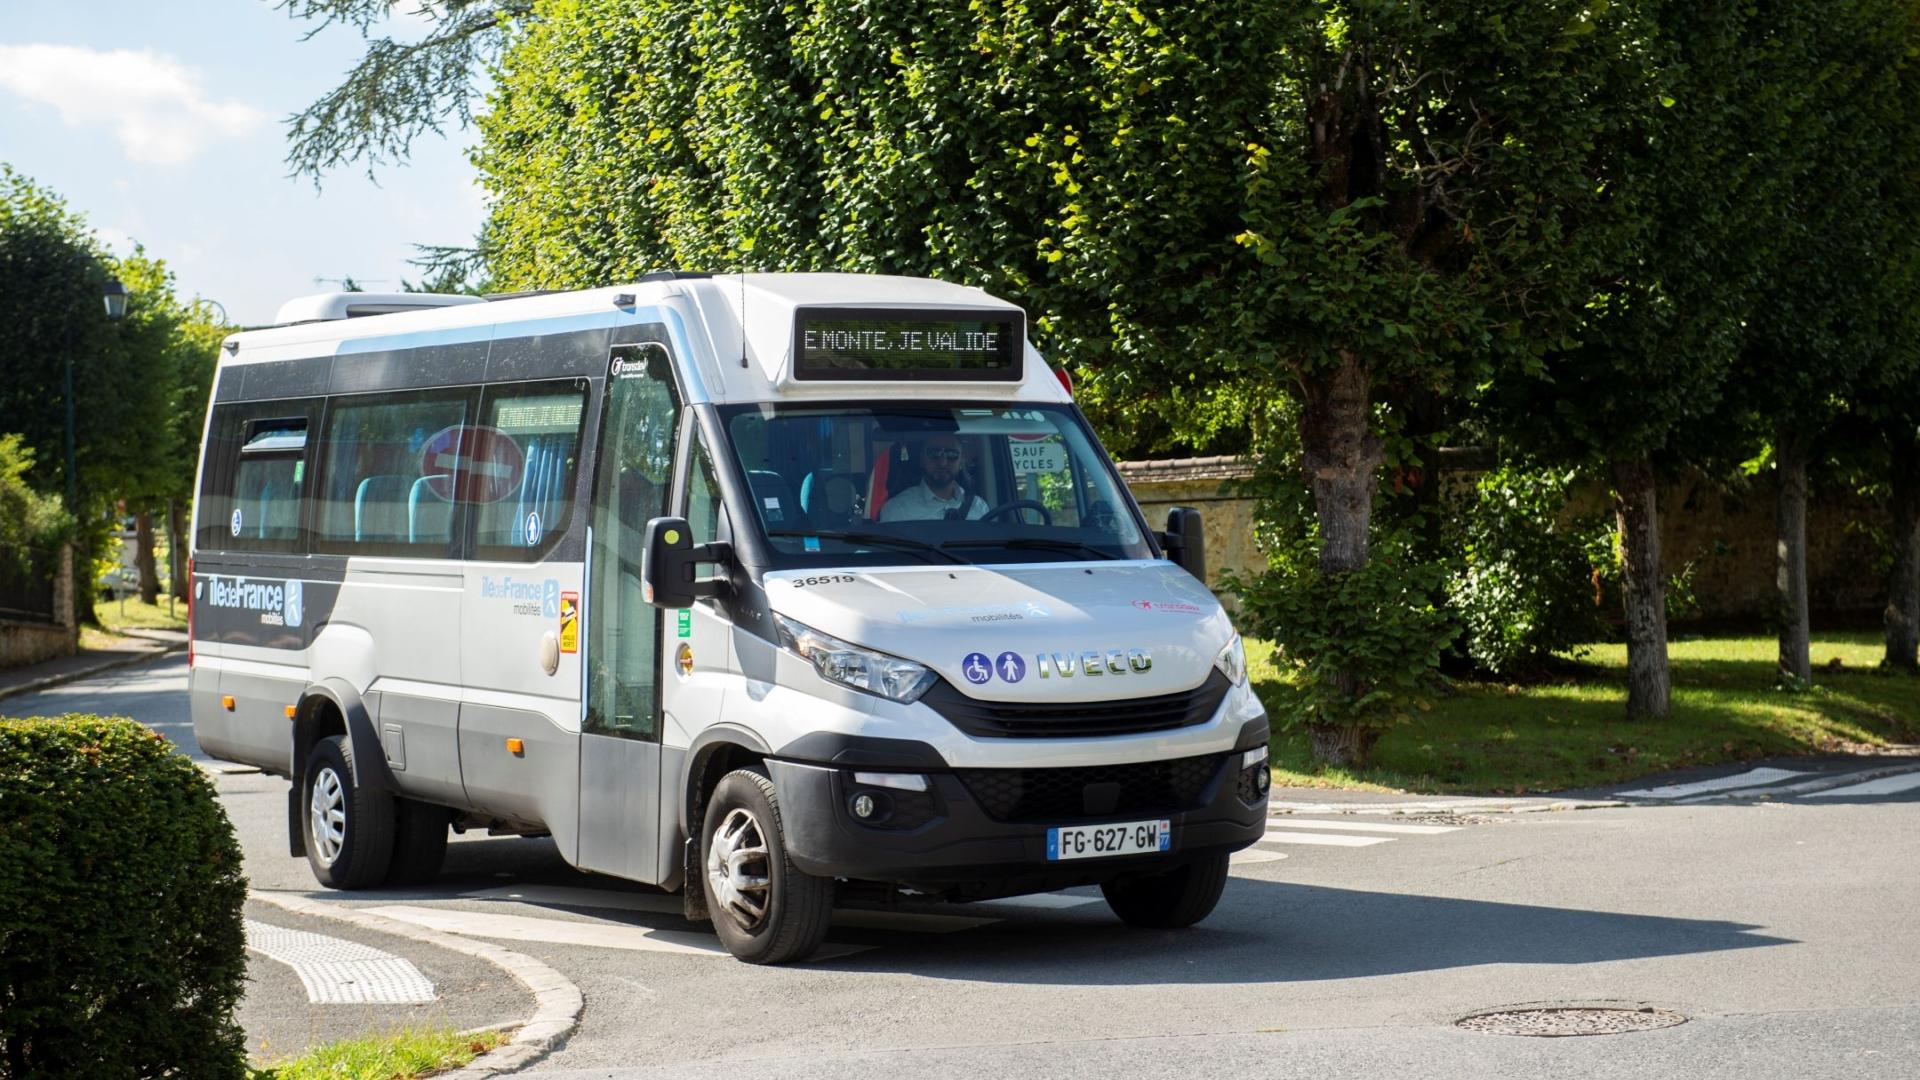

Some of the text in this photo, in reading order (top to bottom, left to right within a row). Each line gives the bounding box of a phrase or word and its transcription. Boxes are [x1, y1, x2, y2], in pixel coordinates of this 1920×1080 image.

[822, 330, 893, 350] MONTE,
[897, 331, 923, 350] JE
[927, 331, 998, 351] VALIDE
[1013, 446, 1045, 457] SAUF
[1014, 458, 1054, 470] YCLES
[792, 575, 855, 588] 36519
[1036, 648, 1153, 679] IVECO
[1062, 825, 1157, 855] FG-627-GW
[1160, 834, 1169, 846] 77
